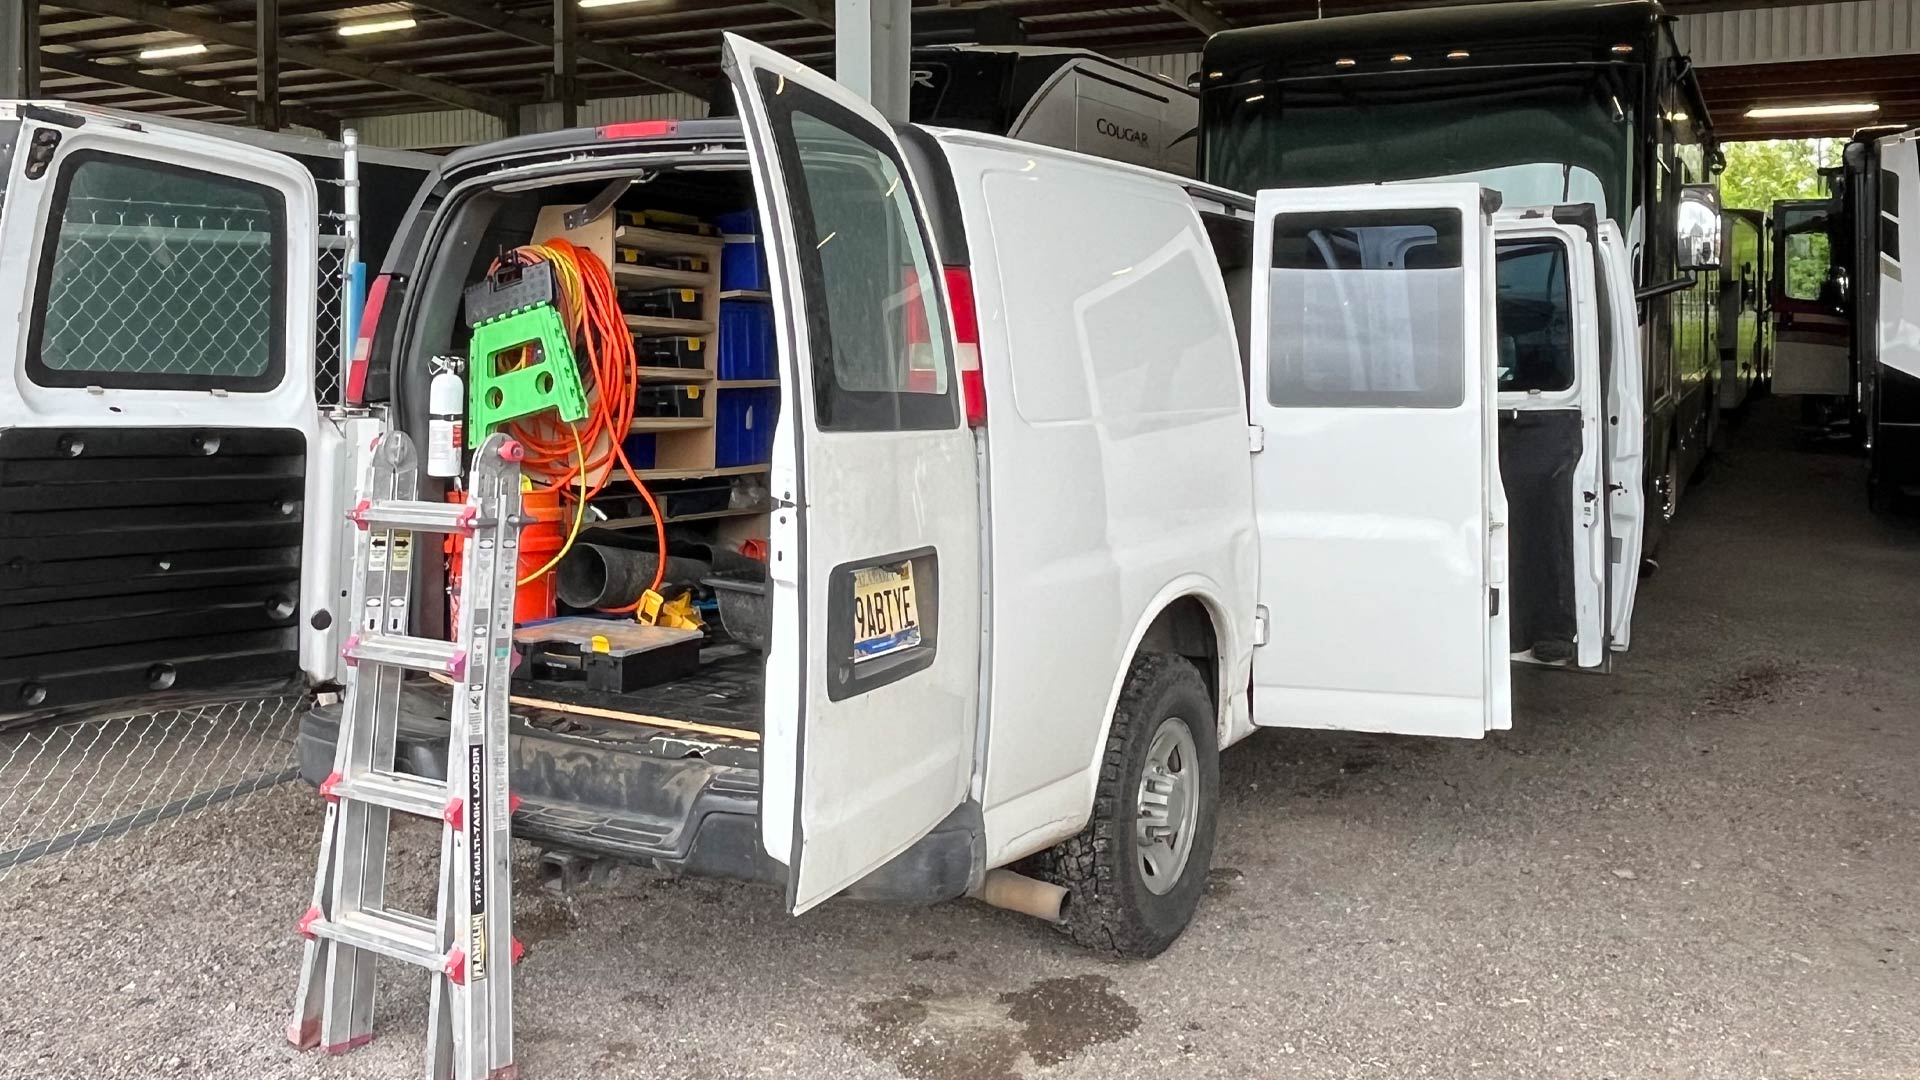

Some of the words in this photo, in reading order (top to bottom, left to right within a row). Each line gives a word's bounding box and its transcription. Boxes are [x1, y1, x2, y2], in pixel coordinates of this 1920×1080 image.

[1096, 118, 1149, 149] COUGAR
[472, 747, 480, 798] LADDER
[473, 800, 481, 877] MULTI-TASK
[472, 915, 484, 977] FRANKLIN
